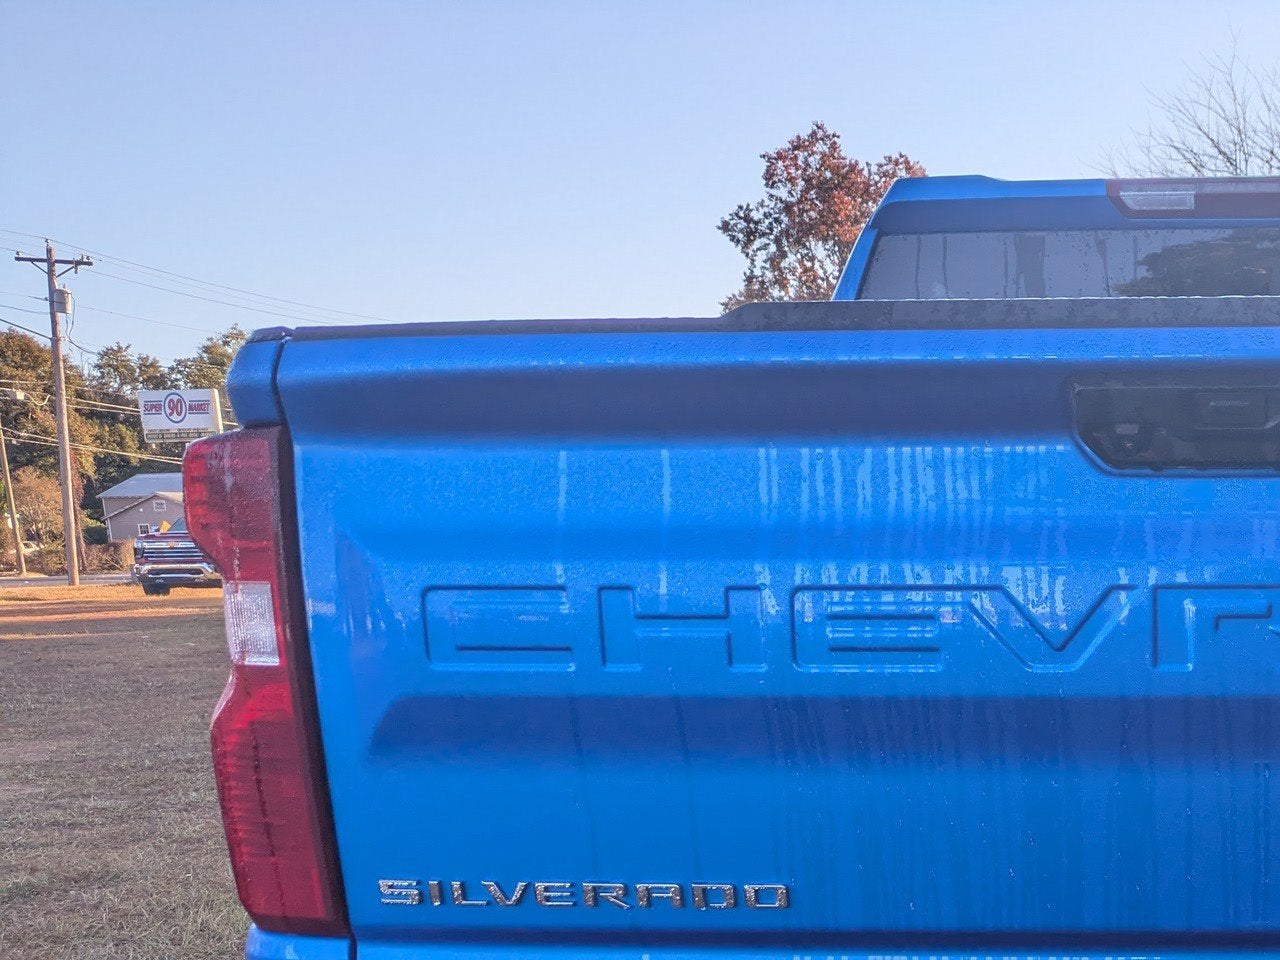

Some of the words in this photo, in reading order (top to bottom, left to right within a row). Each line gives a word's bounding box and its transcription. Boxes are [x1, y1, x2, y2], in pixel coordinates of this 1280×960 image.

[143, 403, 162, 412] SUPER
[167, 398, 183, 417] 90
[188, 402, 210, 412] MARKET
[377, 879, 791, 910] SILVERADO
